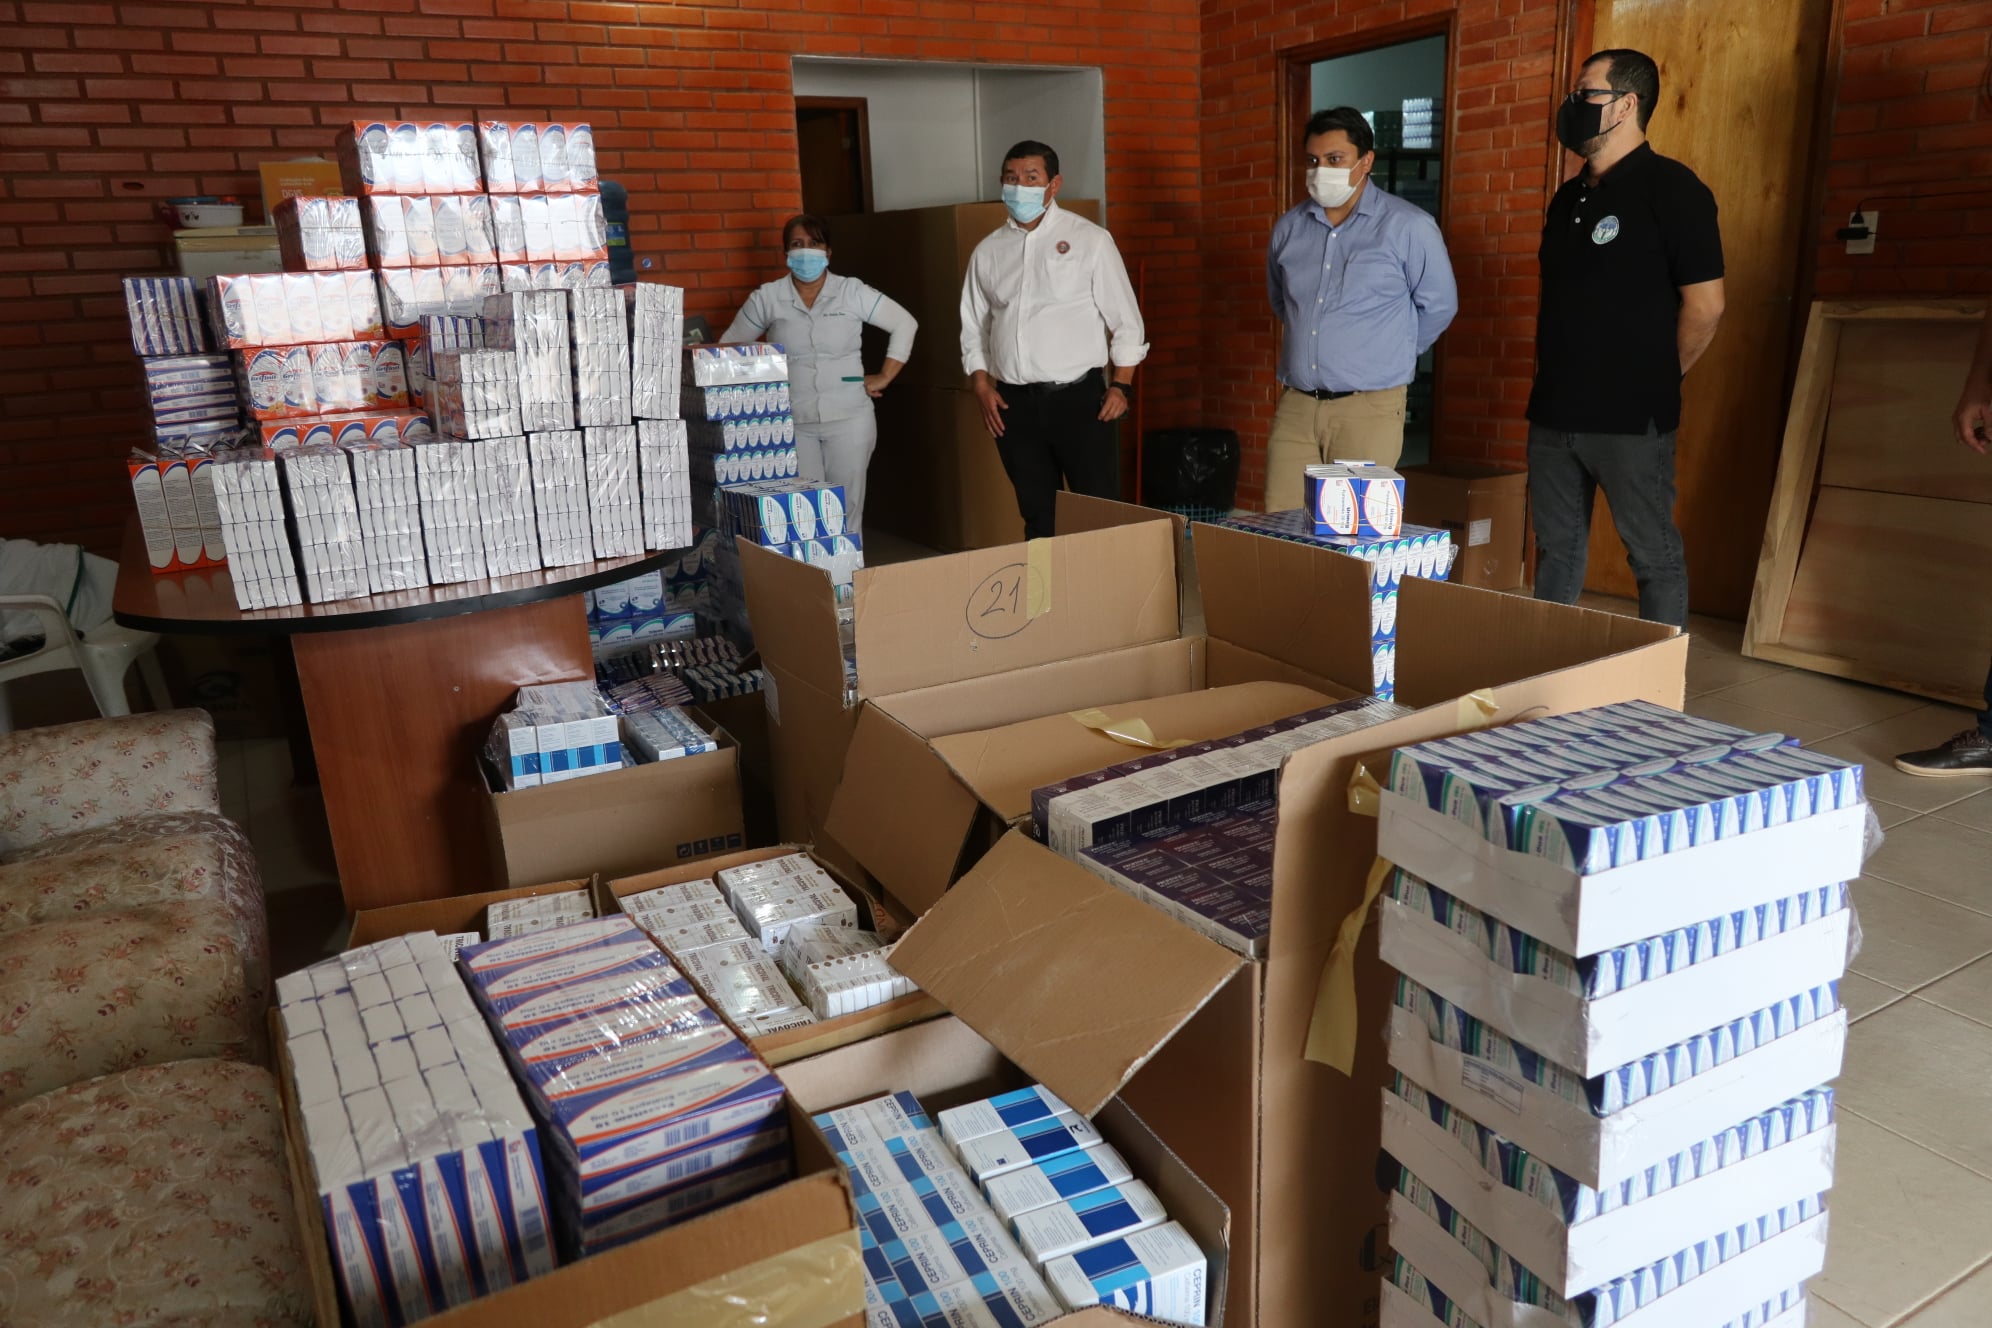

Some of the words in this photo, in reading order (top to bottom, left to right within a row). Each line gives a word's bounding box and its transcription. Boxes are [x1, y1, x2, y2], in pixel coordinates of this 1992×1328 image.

[980, 576, 1021, 617] 21
[688, 952, 704, 973] TRICOVAL
[740, 941, 755, 962] TRICOVAL
[753, 961, 769, 983] TRICOVAL
[700, 973, 717, 995] TRICOVAL
[767, 984, 784, 1007] TRICOVAL
[767, 1019, 813, 1034] TRICOVAL
[841, 1122, 858, 1146] CEPRIN
[916, 1147, 934, 1172] CEPRIN
[863, 1162, 881, 1187] CEPRIN
[936, 1174, 947, 1187] 100
[880, 1191, 892, 1204] 100
[944, 1187, 965, 1215] CEPRIN
[888, 1204, 909, 1233] CEPRIN
[965, 1219, 978, 1233] 100
[908, 1237, 921, 1251] 100
[975, 1233, 998, 1264] CEPRIN
[916, 1252, 940, 1284] CEPRIN
[998, 1269, 1013, 1286] 100
[940, 1290, 955, 1308] 100
[1009, 1286, 1035, 1322] CEPRIN
